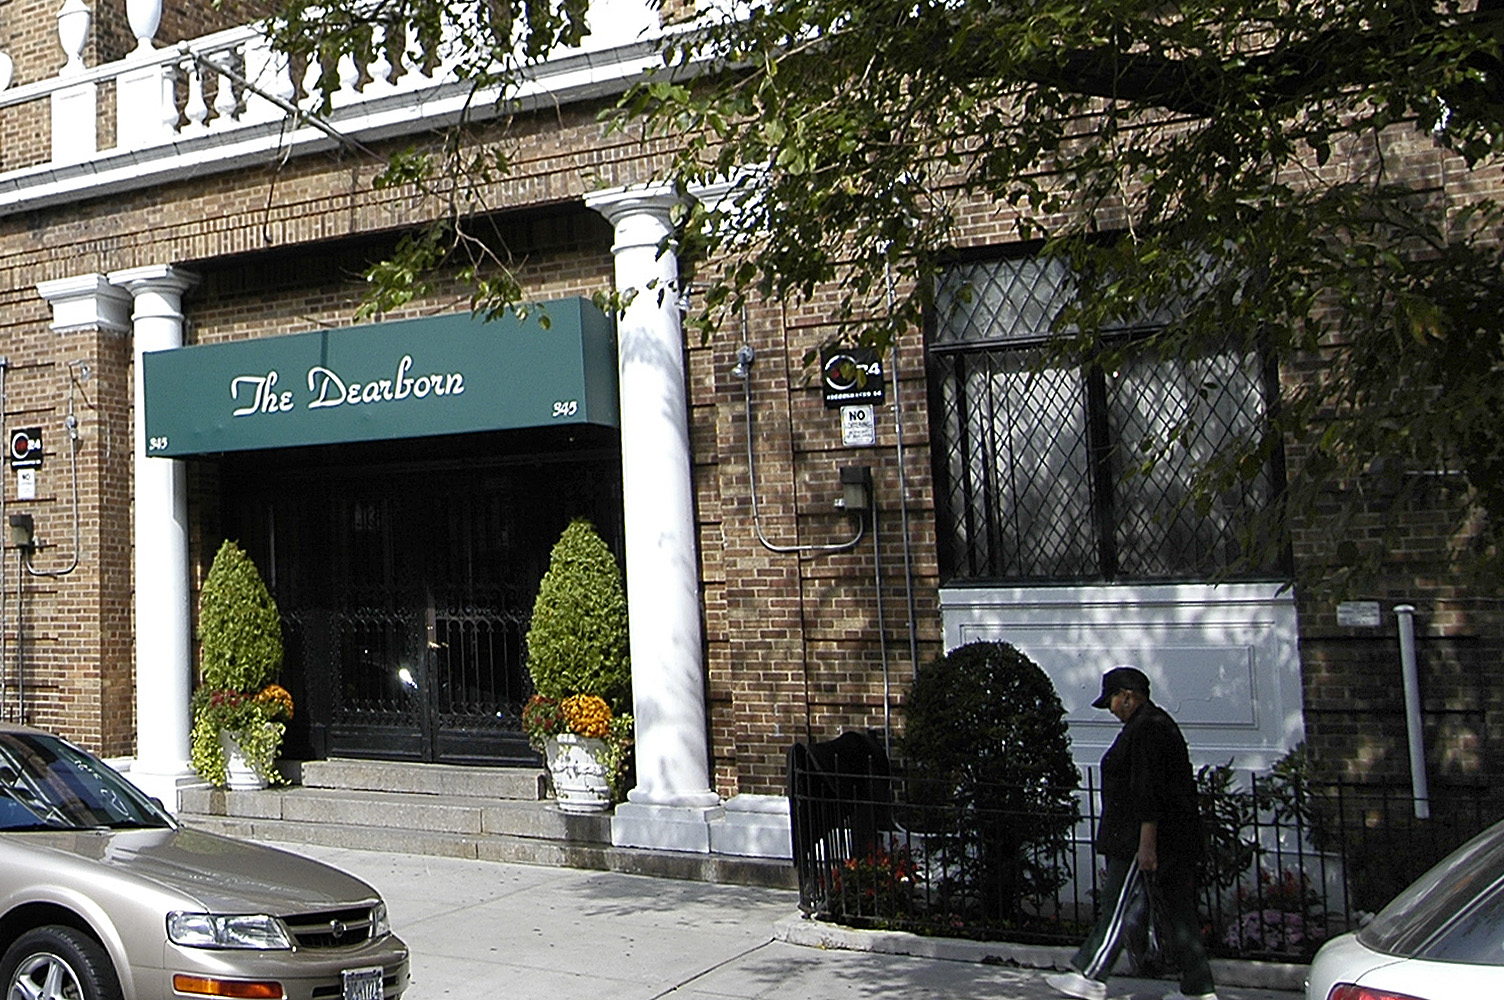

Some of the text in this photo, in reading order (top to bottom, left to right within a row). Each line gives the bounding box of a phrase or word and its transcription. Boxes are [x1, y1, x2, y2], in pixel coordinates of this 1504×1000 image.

[231, 355, 464, 416] The Dearborn
[552, 401, 577, 417] 345
[848, 410, 866, 421] NO
[148, 436, 168, 451] 345
